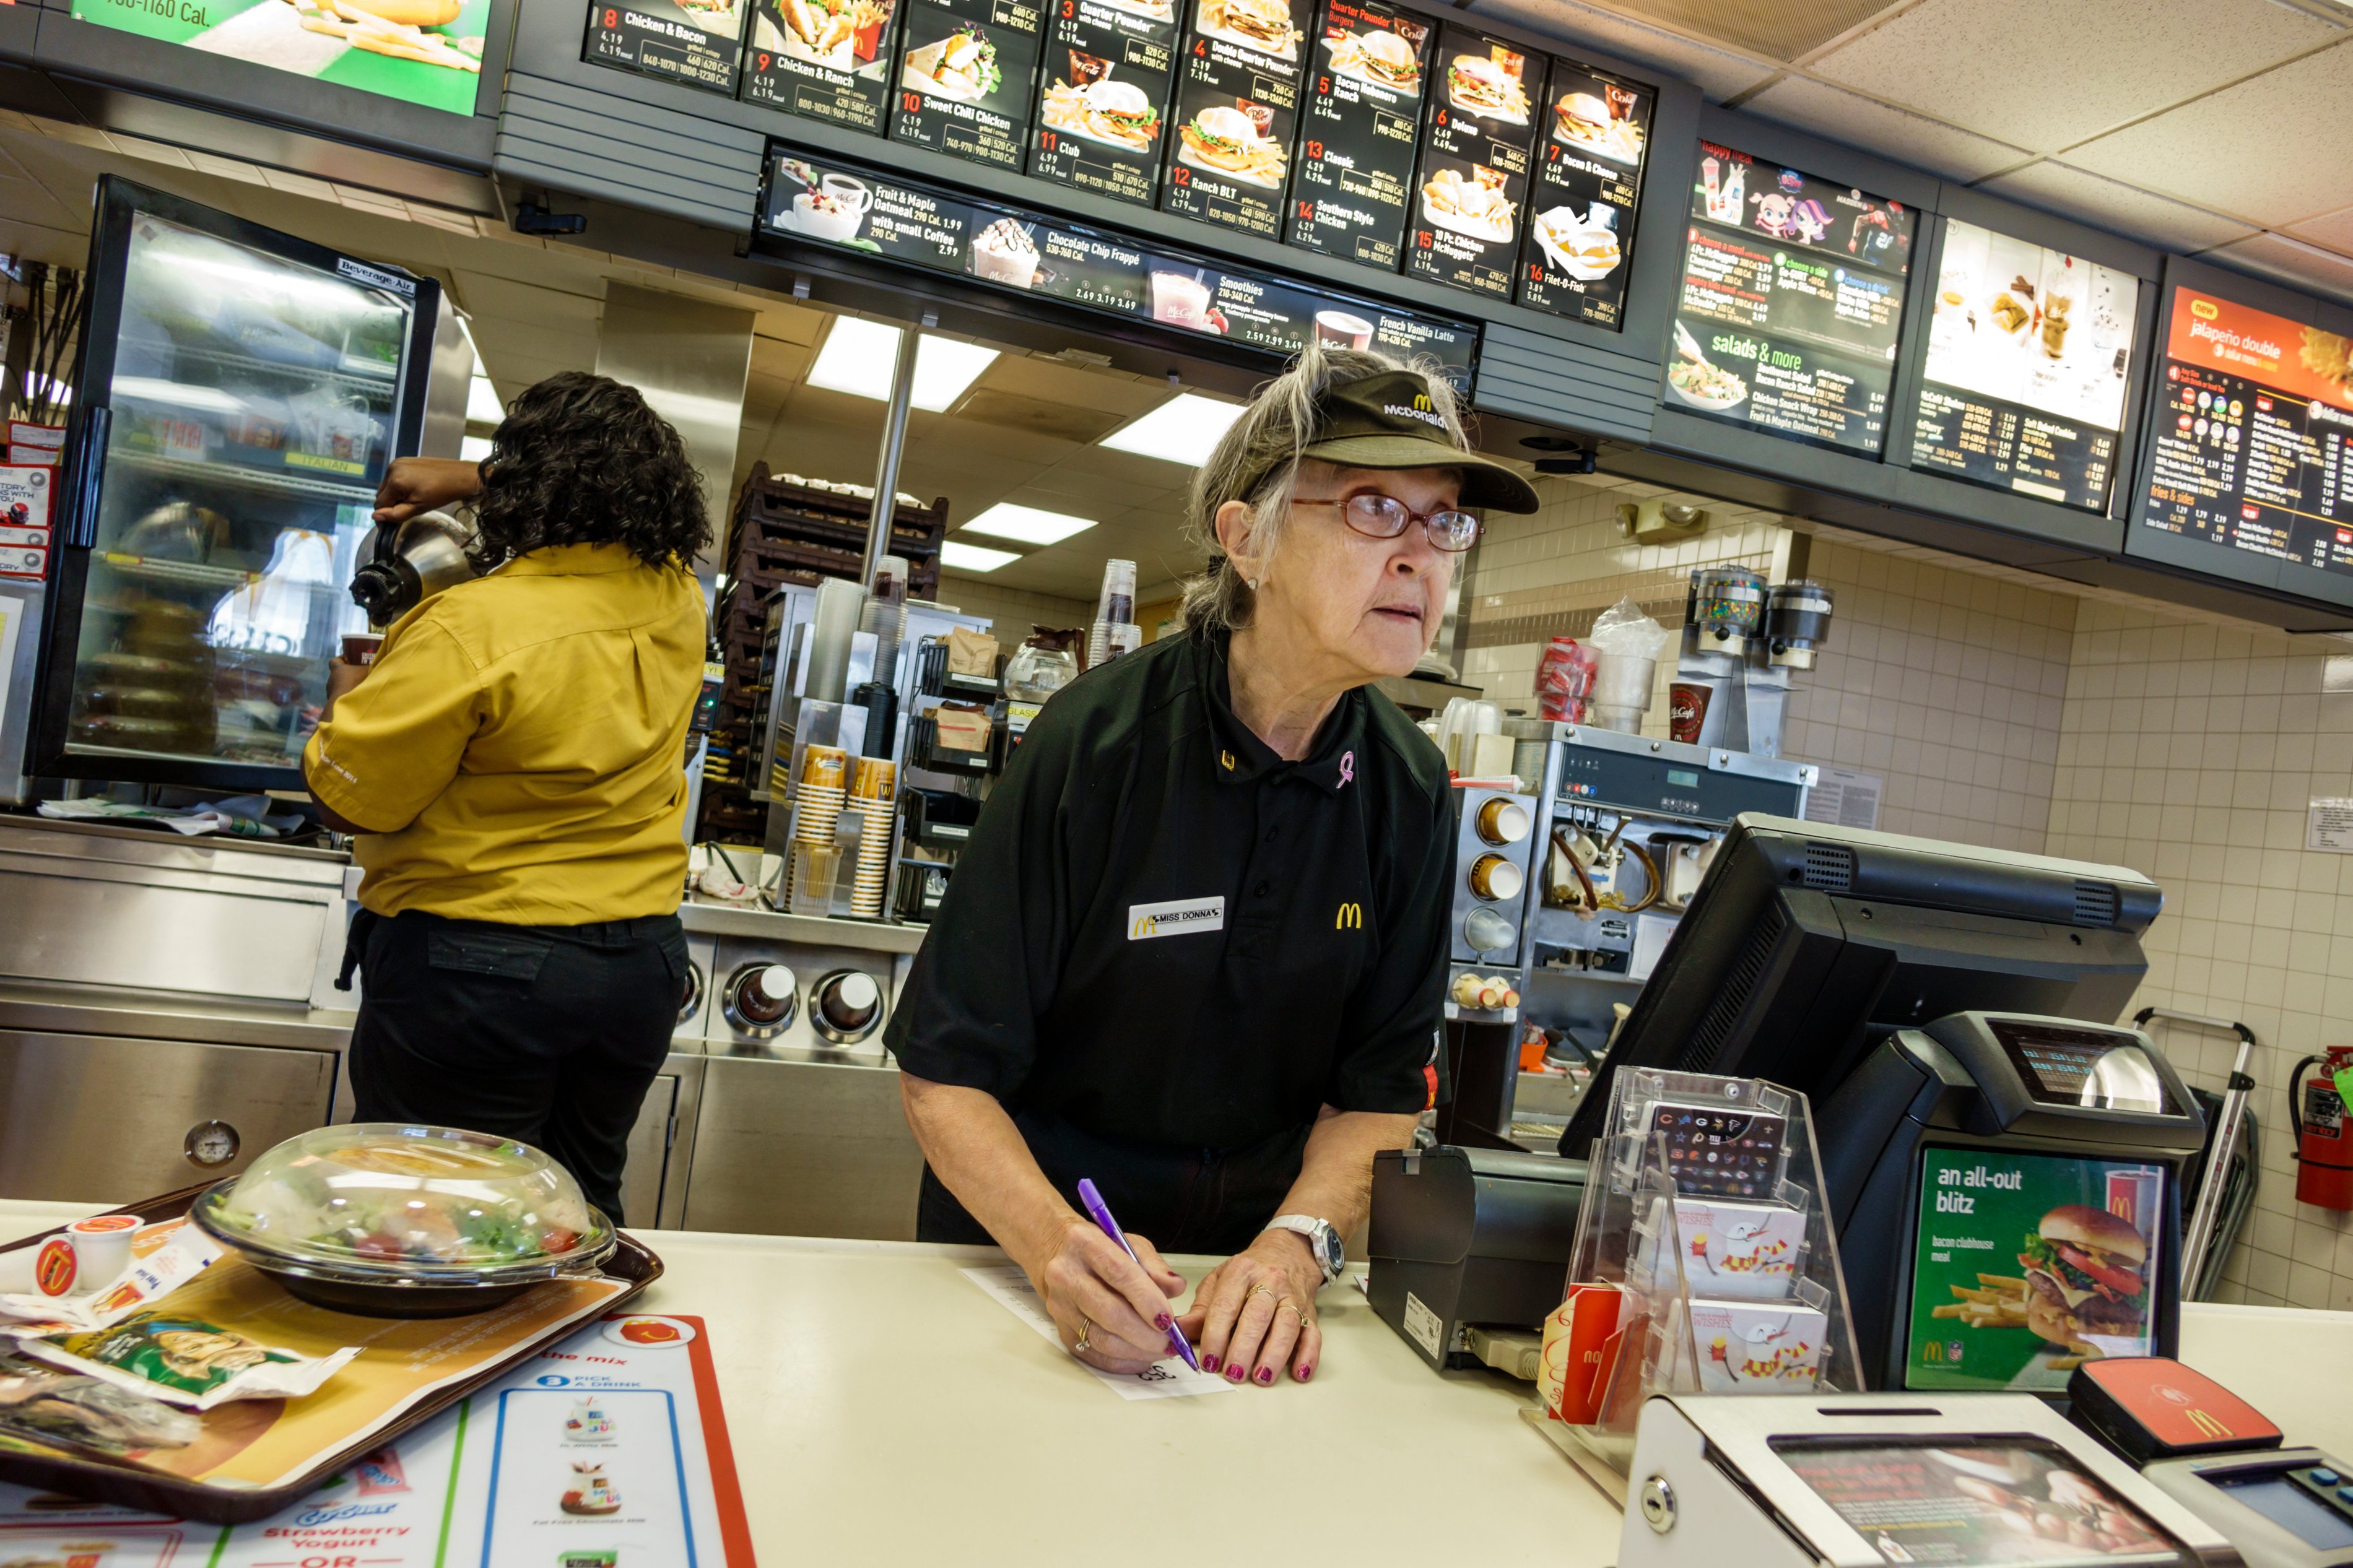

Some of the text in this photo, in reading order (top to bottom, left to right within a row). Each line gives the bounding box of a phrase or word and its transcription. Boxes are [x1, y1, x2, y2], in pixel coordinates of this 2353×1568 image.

[181, 2, 210, 27] Cal.
[1062, 1, 1074, 18] 3
[1080, 1, 1113, 22] Quarter
[1328, 11, 1354, 28] Burgers
[1330, 0, 1391, 27] Quarter Pounder
[604, 9, 707, 45] 8 Chicken & Bacon
[1079, 14, 1112, 30] with cheese
[1329, 28, 1344, 40] new
[1401, 25, 1426, 41] Coke
[620, 51, 633, 61] meal
[1158, 49, 1169, 61] Cal.
[1194, 40, 1206, 57] 4
[1212, 40, 1238, 59] Double
[1237, 48, 1265, 67] Quarter
[758, 53, 854, 88] 9 Chicken & Ranch
[1156, 60, 1168, 72] Cal.
[1319, 75, 1398, 104] 5 Bacon Habanero
[1333, 87, 1359, 103] Ranch
[1611, 90, 1635, 105] Coke
[902, 93, 1011, 131] 10 Sweet Chili Chicken
[1438, 110, 1478, 136] 6 Deluxe
[1040, 131, 1080, 157] 11 Club
[1702, 140, 1752, 165] happy meal
[1307, 141, 1354, 169] 13 Classic
[1550, 144, 1618, 181] 7 Bacon & Cheese
[1173, 167, 1237, 199] 12 Ranch BLT
[875, 186, 936, 212] Fruit & Maple
[874, 200, 962, 230] Oatmeal 290 Cal. 1.99
[1298, 200, 1375, 227] 14 Southern Style
[1315, 211, 1347, 230] Chicken
[872, 215, 955, 246] with small Coffee
[1047, 232, 1140, 266] Chocolate Chip Frappé
[1418, 231, 1432, 249] 15
[1435, 229, 1443, 241] 10
[1454, 235, 1484, 253] Chicken
[1698, 236, 1745, 255] choose meal
[938, 245, 958, 257] 2.99
[1046, 243, 1085, 262] 530-760 Cal.
[1529, 264, 1543, 282] 16
[1786, 259, 1809, 272] choose
[1219, 275, 1264, 297] Smoothies
[1845, 275, 1866, 290] choose
[1076, 288, 1136, 310] 2.69 3.19 3.69
[1218, 287, 1255, 305] 210-340 Cal.
[2196, 303, 2214, 315] new
[1380, 316, 1406, 332] French
[1407, 322, 1433, 338] Vanilla
[1434, 329, 1455, 343] Latte
[2190, 319, 2281, 359] jalapeño double
[1246, 331, 1264, 342] 2.59
[1284, 338, 1302, 350] 3.49
[1400, 338, 1412, 348] Cal.
[1711, 335, 1802, 371] salads & more
[1753, 391, 1778, 407] Chicken
[303, 455, 349, 471] ITALIAN
[0, 482, 26, 491] TORY
[1159, 909, 1211, 922] MISS DONNA
[1938, 1166, 2022, 1190] an all-out
[1936, 1191, 1975, 1215] blitz
[1677, 1215, 1714, 1227] WISHES
[1932, 1236, 1994, 1250] bacon clubhouse
[1931, 1250, 1951, 1262] meal
[1694, 1317, 1732, 1329] WISHES
[586, 1356, 627, 1366] mix
[264, 1527, 411, 1538] Strawberry
[292, 1538, 378, 1549] Yogurt
[300, 1556, 357, 1568] OR
